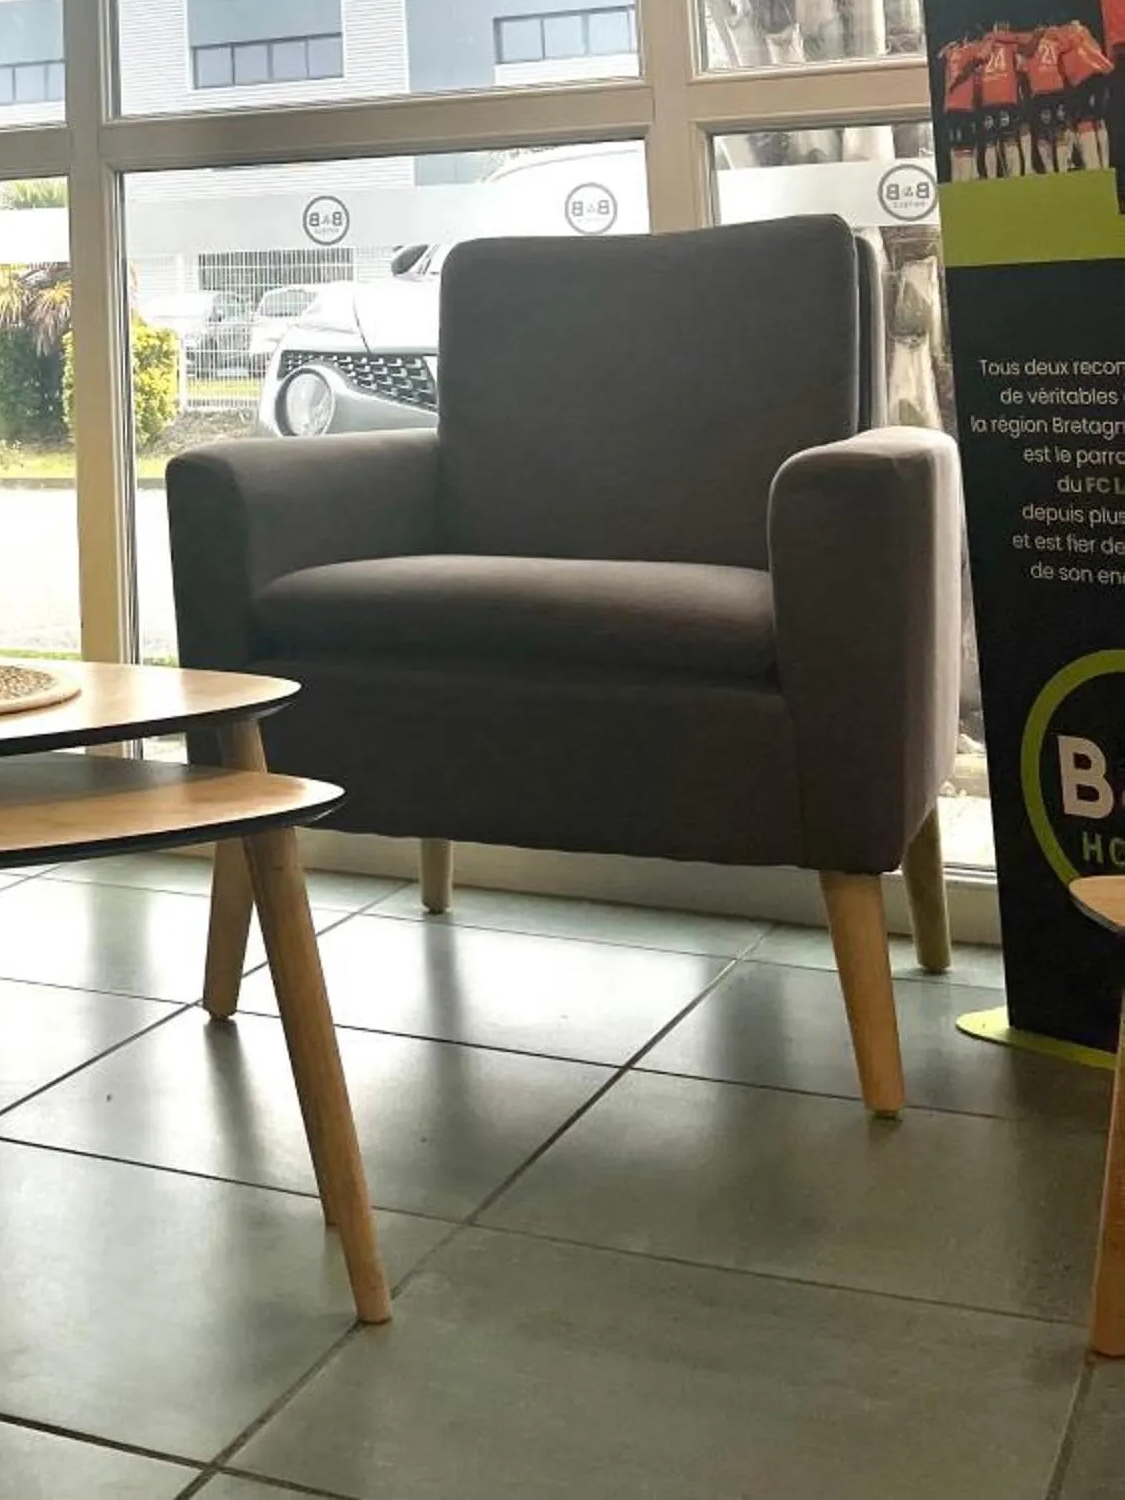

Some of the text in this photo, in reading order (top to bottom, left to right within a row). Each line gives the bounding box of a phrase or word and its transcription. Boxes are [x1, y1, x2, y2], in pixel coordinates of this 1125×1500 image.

[979, 358, 1020, 376] Tous
[1024, 358, 1069, 375] deux
[1000, 388, 1023, 405] de
[1026, 387, 1119, 405] véritables
[970, 414, 987, 434] la
[990, 414, 1048, 439] région
[1023, 445, 1052, 463] est
[1054, 445, 1072, 464] le
[1057, 474, 1082, 493] du
[1084, 476, 1111, 494] FC
[1022, 503, 1084, 526] depuis
[1012, 533, 1032, 550] et
[1034, 534, 1064, 552] est
[1066, 533, 1095, 554] fier
[1030, 561, 1125, 586] de son en
